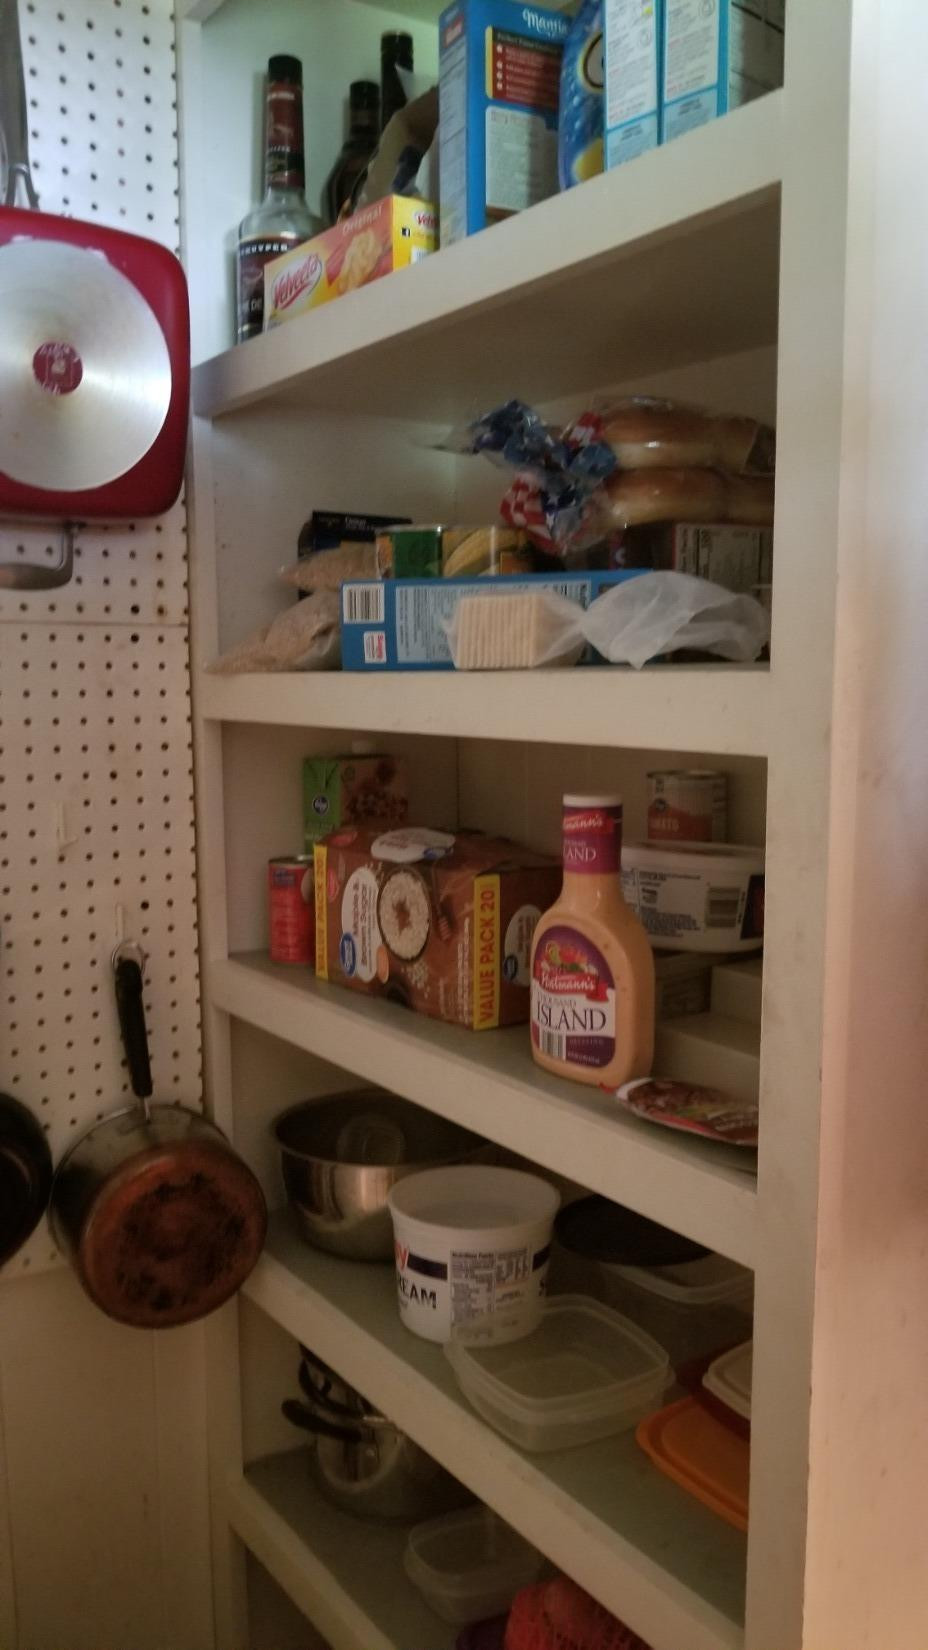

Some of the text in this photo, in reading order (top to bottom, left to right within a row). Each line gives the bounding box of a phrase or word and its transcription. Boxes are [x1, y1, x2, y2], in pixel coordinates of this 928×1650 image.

[342, 202, 385, 235] Original
[274, 252, 320, 310] Velveeta
[480, 890, 495, 1023] VALUE PACK 20
[537, 1001, 608, 1032] ISLAND
